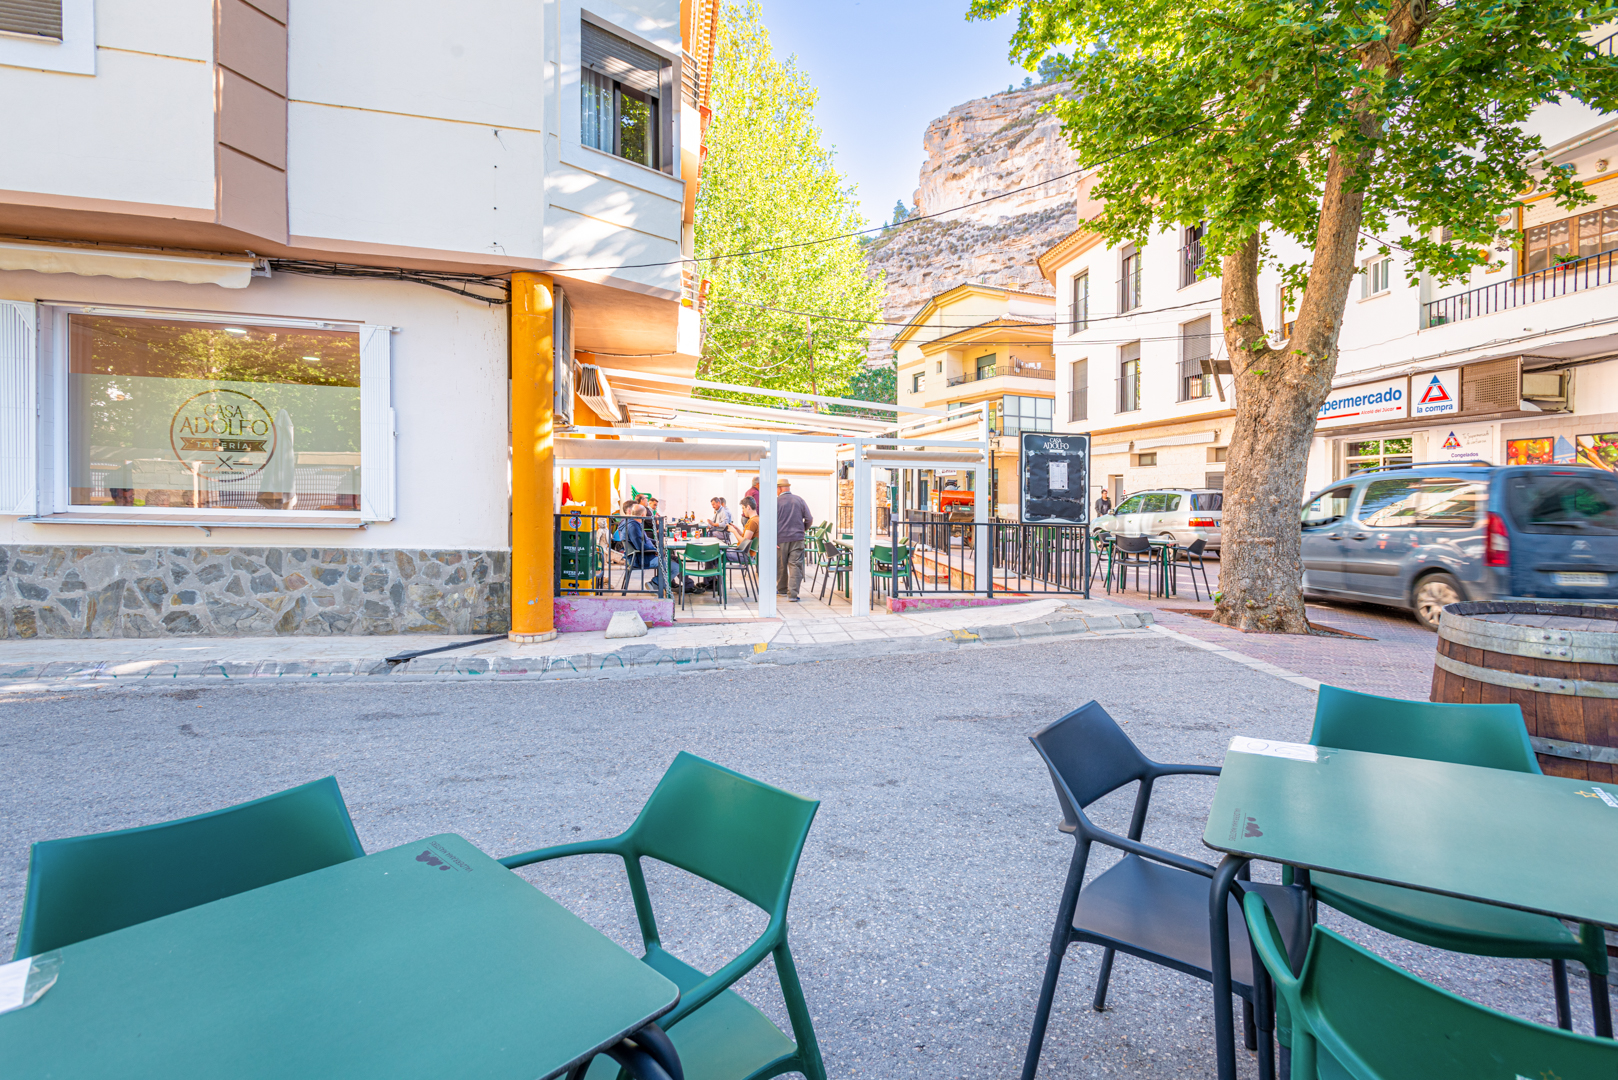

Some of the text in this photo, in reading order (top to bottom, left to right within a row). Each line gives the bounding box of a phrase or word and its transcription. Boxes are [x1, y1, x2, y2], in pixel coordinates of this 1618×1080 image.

[204, 404, 244, 419] CASA
[1425, 403, 1453, 413] compra
[180, 416, 268, 436] ADOLFO
[196, 441, 249, 449] TAPERÍA
